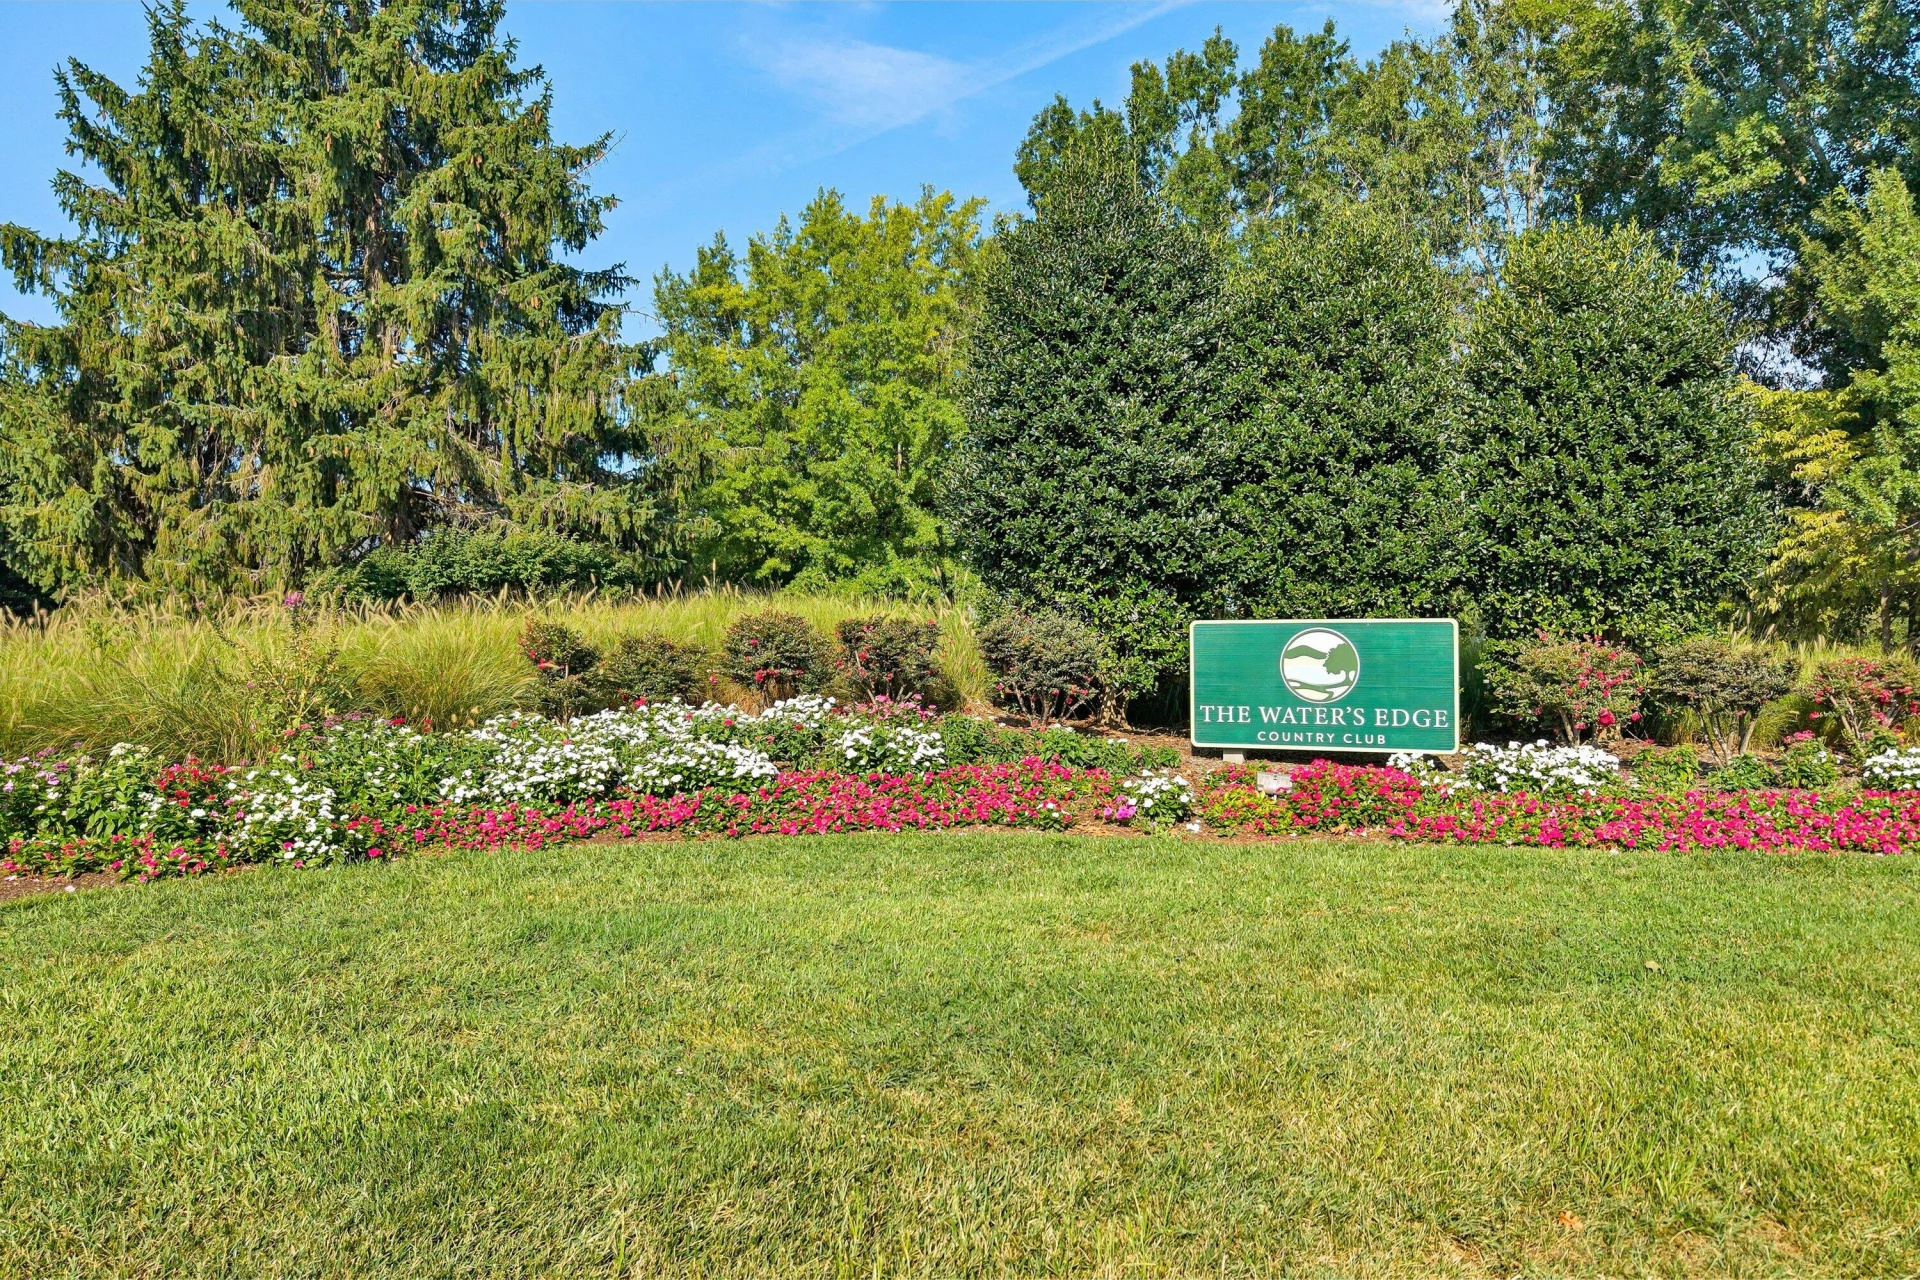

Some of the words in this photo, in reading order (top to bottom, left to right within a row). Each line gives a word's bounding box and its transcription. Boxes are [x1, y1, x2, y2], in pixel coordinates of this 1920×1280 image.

[1199, 705, 1251, 723] THE
[1259, 706, 1366, 726] WATER'S
[1374, 709, 1449, 728] EDGE
[1257, 731, 1336, 743] COUNTRY
[1343, 733, 1386, 745] CLUB
